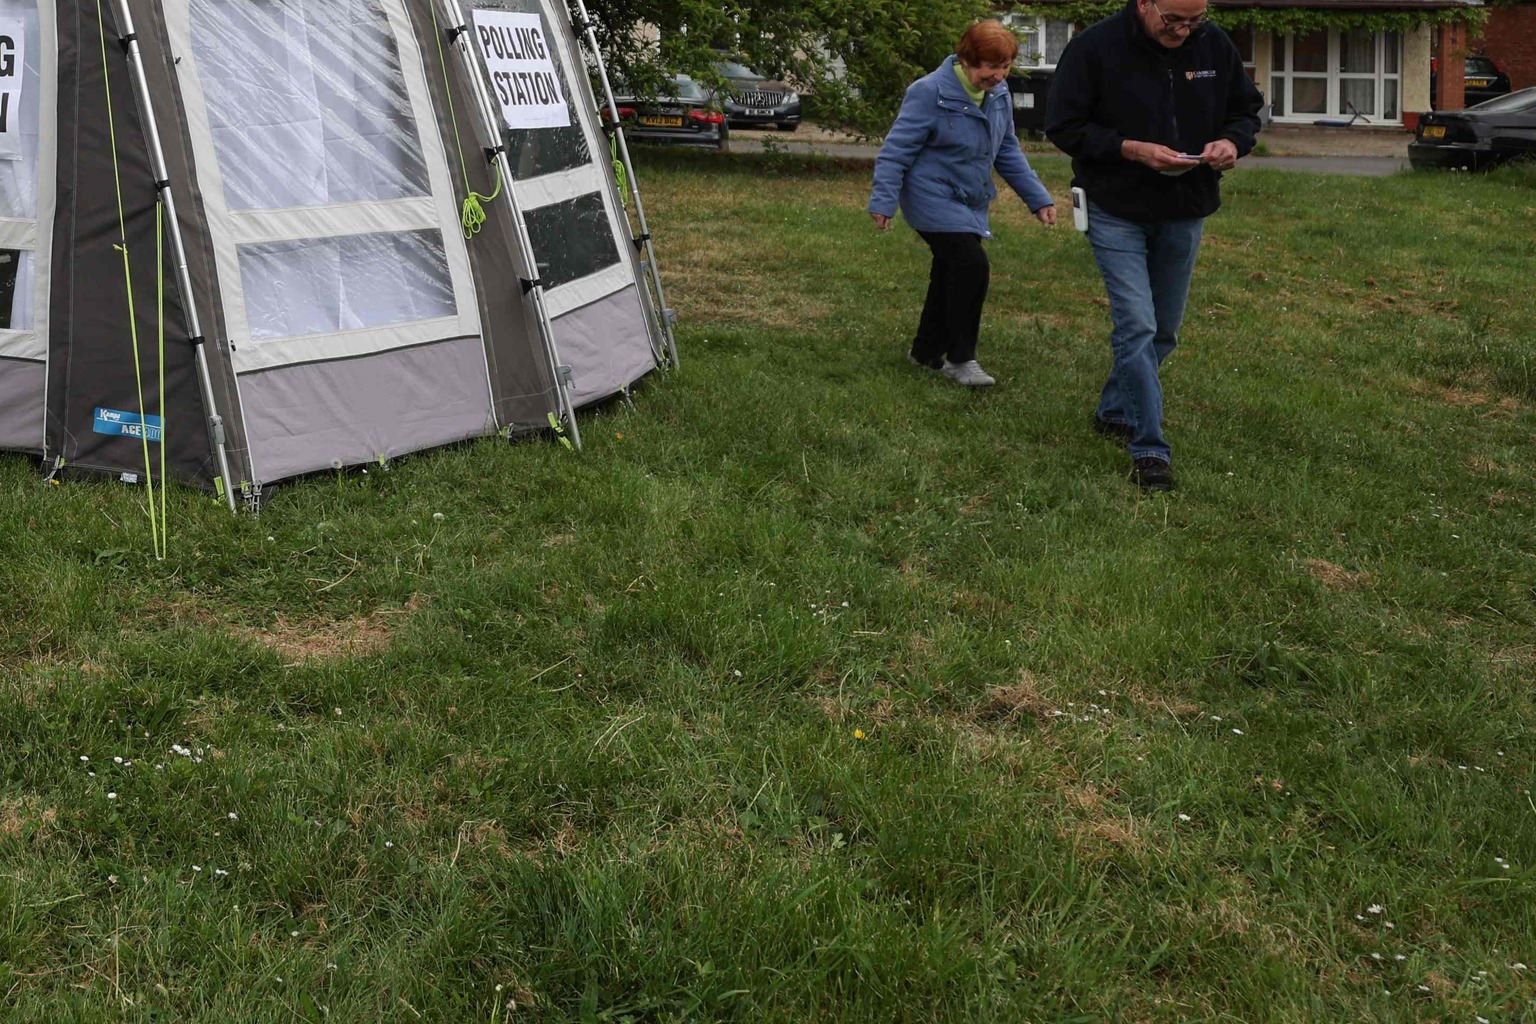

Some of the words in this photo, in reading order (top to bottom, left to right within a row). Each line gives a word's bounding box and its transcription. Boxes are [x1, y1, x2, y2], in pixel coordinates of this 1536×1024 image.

[478, 25, 547, 60] POLLING
[494, 71, 561, 106] STATION
[121, 424, 142, 436] ACE
